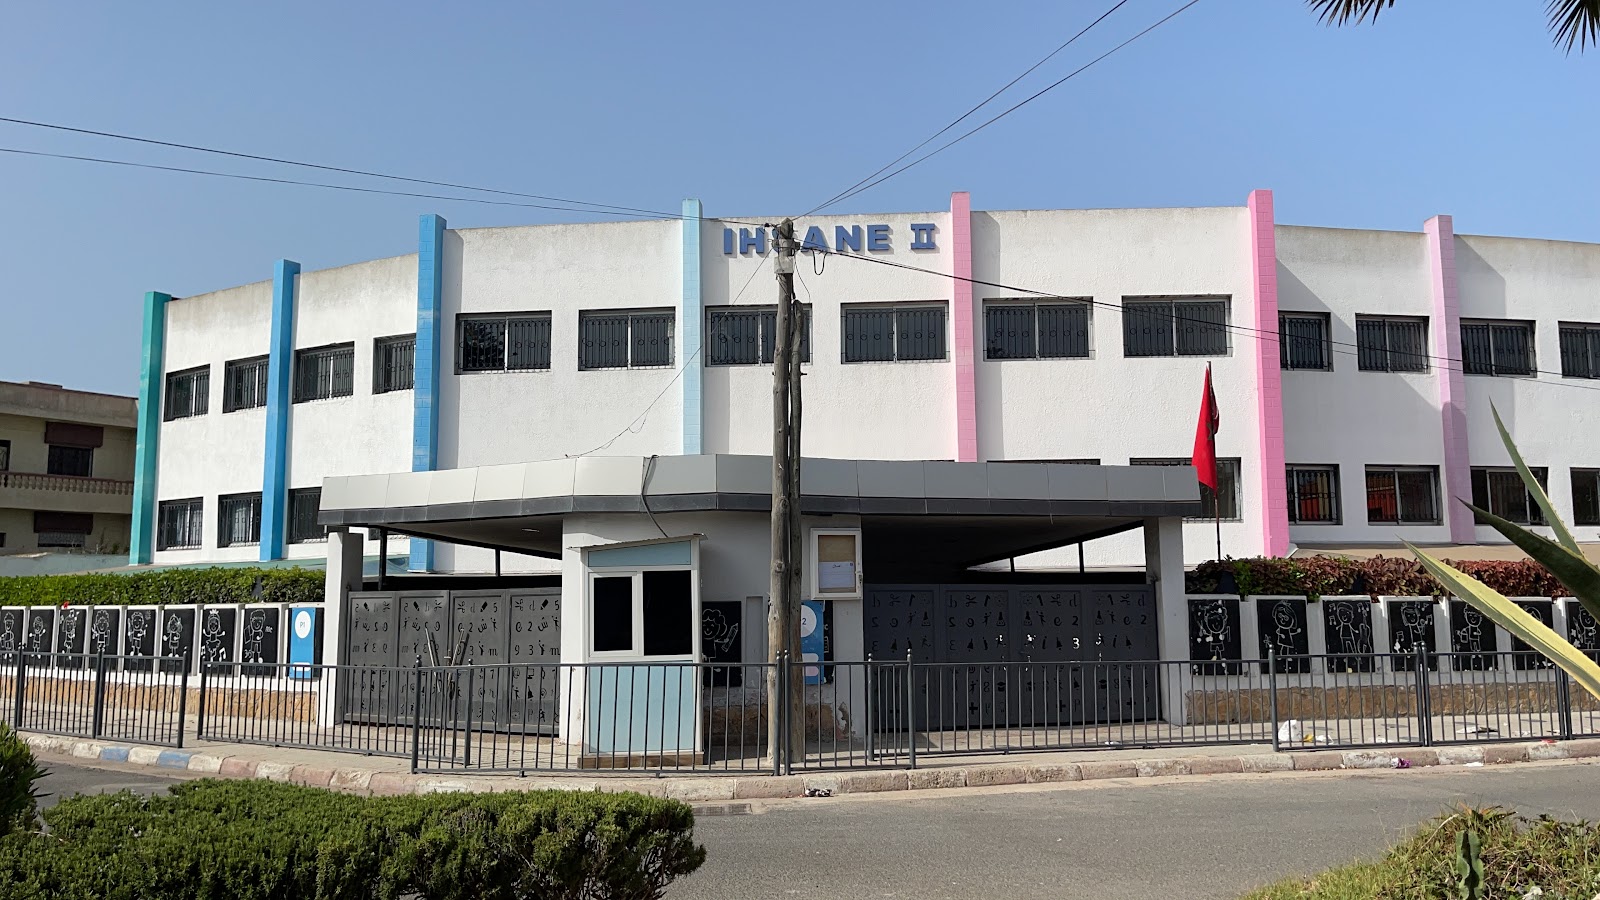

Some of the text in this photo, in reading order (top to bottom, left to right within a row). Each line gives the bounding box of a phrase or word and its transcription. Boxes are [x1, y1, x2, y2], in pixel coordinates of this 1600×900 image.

[1072, 616, 1078, 625] 2
[1141, 615, 1146, 624] 2
[528, 622, 532, 632] 2
[1072, 637, 1080, 649] 3
[529, 645, 533, 655] 3
